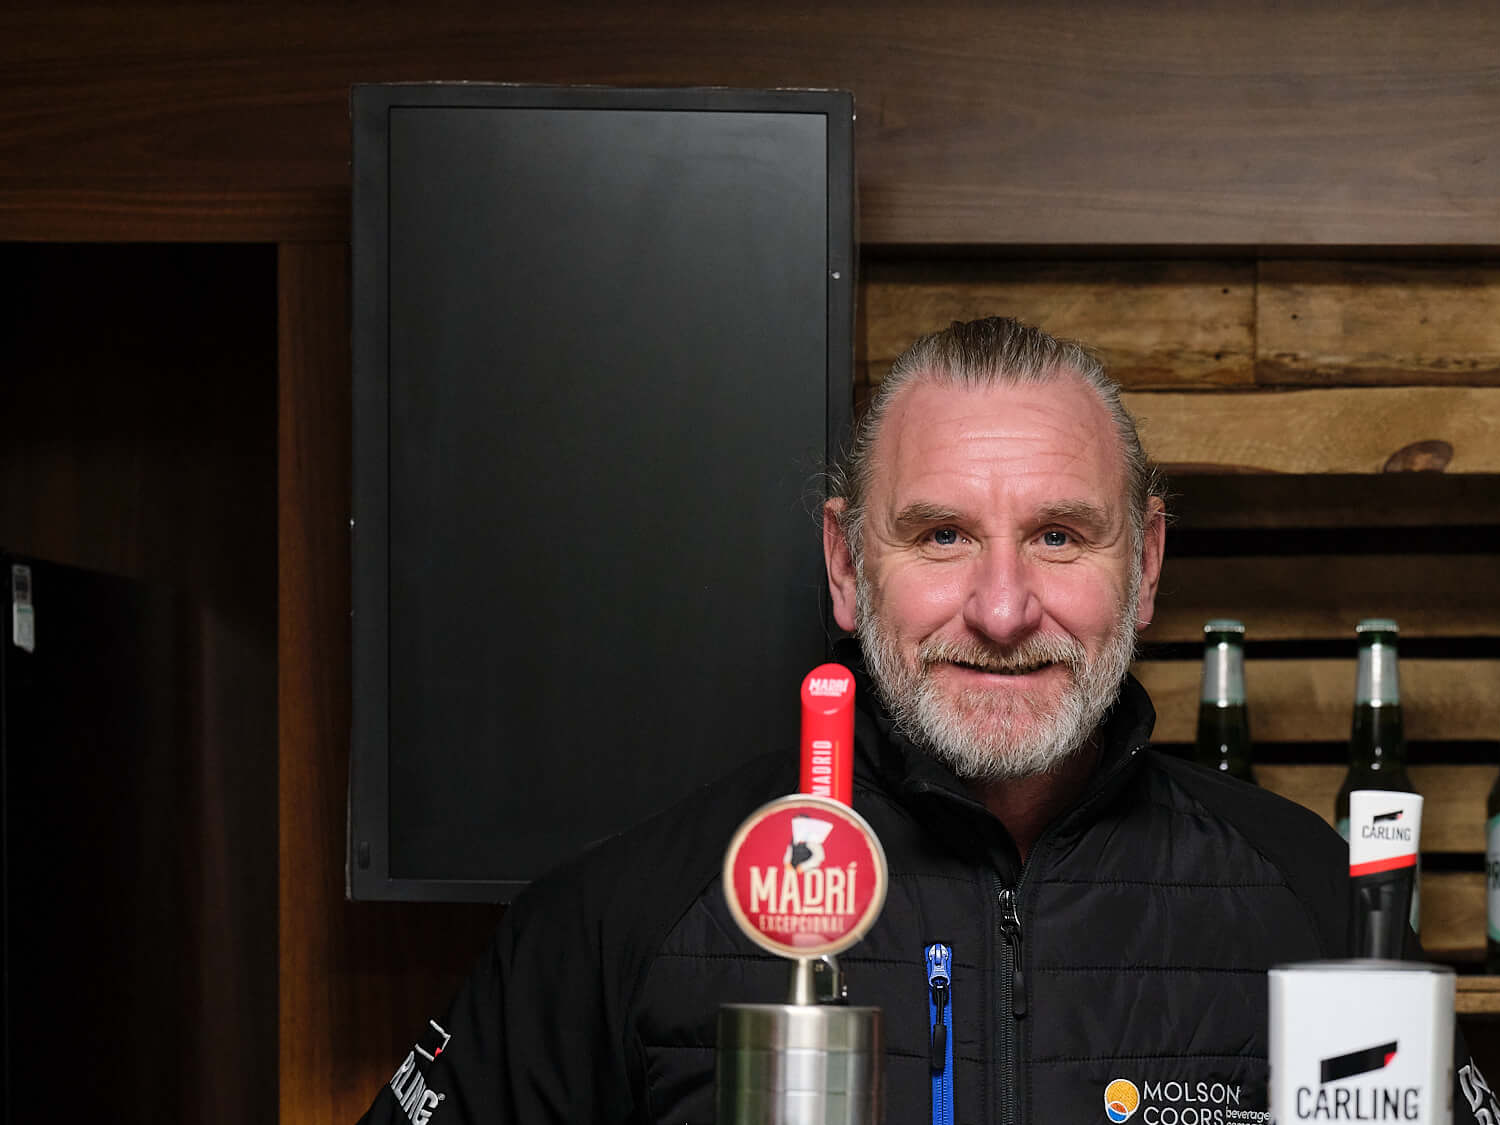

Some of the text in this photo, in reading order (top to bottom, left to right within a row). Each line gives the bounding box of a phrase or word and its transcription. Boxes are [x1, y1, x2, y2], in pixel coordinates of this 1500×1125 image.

[1362, 826, 1411, 841] CARLING
[750, 861, 857, 914] MADRÍ
[1143, 1081, 1241, 1105] MOLSON
[1297, 1087, 1419, 1120] CARLING
[1225, 1106, 1271, 1123] beverage
